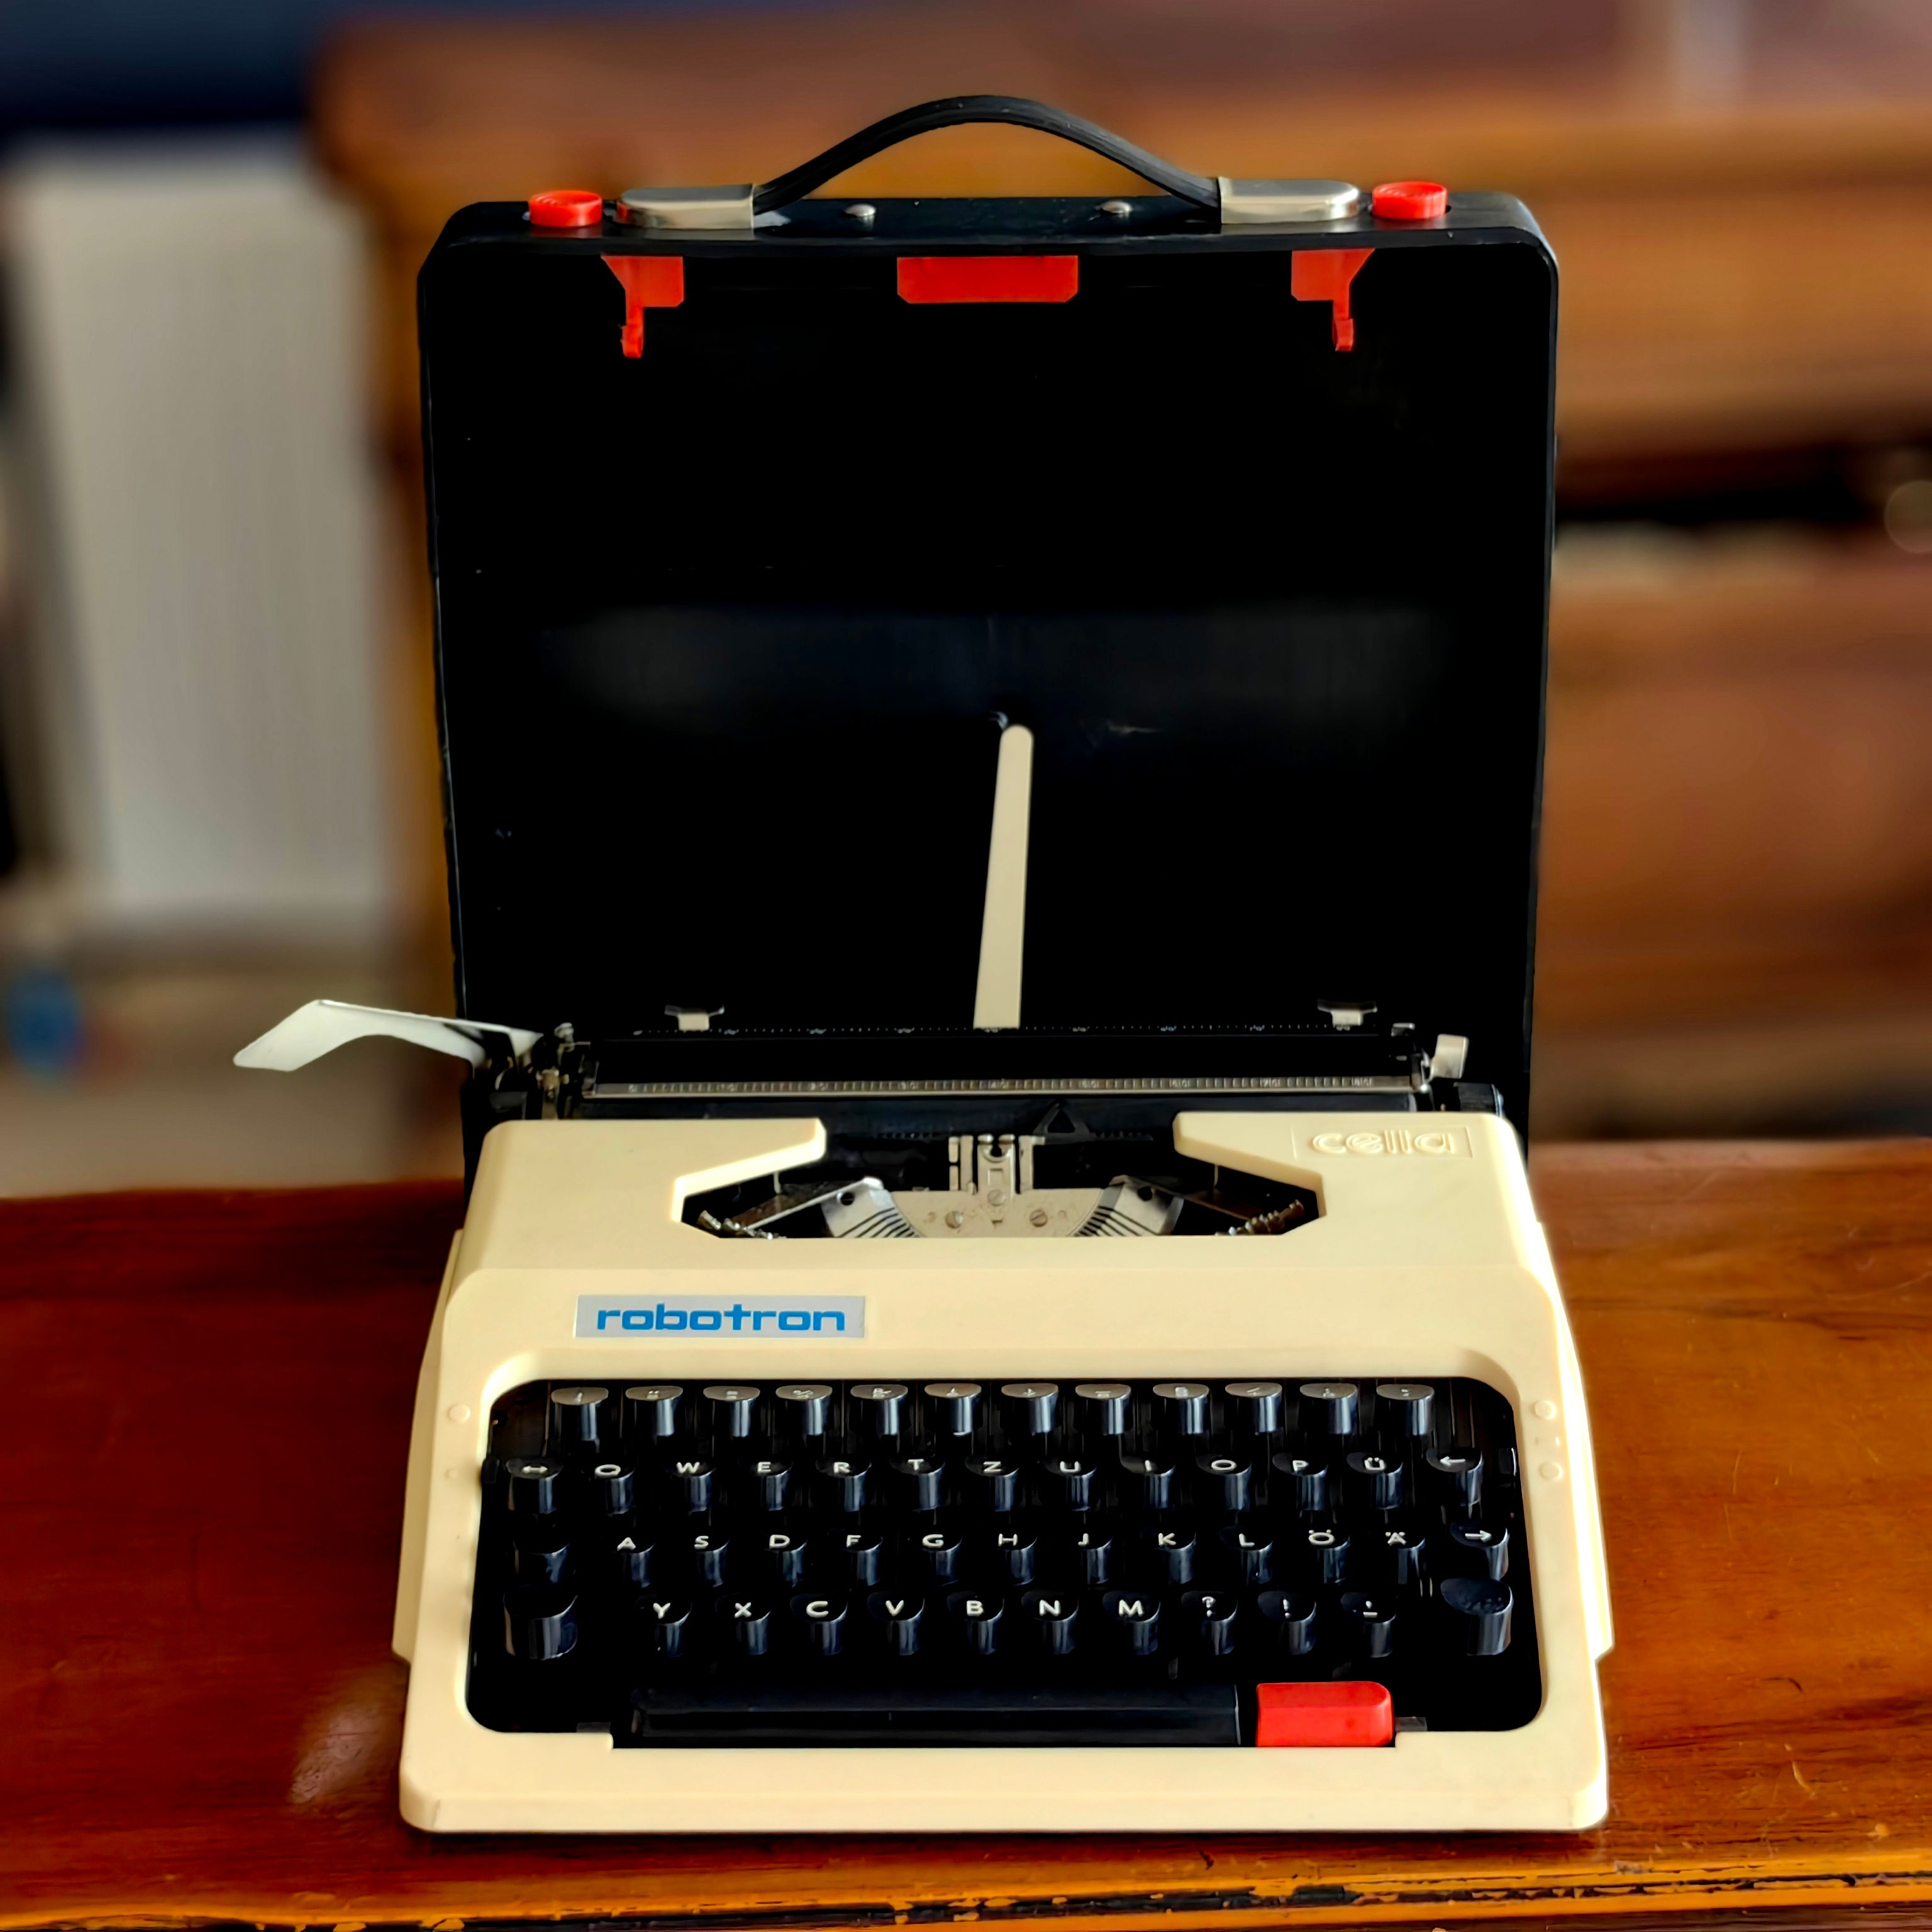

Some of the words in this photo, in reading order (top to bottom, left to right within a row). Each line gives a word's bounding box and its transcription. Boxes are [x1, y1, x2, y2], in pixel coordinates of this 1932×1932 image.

[1313, 1130, 1455, 1154] cella
[597, 1304, 845, 1331] robotron
[676, 1462, 700, 1474] W
[757, 1461, 772, 1474] E
[833, 1462, 850, 1474] R
[908, 1458, 924, 1471] T
[983, 1461, 1002, 1474] Z
[1059, 1461, 1080, 1473] U
[1145, 1460, 1152, 1472] I
[1211, 1459, 1236, 1471] O
[1292, 1460, 1308, 1473] P
[1364, 1457, 1385, 1471] Ü
[617, 1536, 636, 1550] A
[694, 1535, 709, 1548] S
[769, 1534, 791, 1548] D
[846, 1535, 862, 1547] F
[922, 1534, 944, 1547] G
[998, 1533, 1018, 1546] H
[1077, 1533, 1089, 1546] J
[1158, 1533, 1177, 1546] K
[1238, 1533, 1255, 1546] L
[1308, 1529, 1335, 1545] Ö
[1385, 1531, 1406, 1545] Ä
[653, 1602, 671, 1619] Y
[734, 1602, 752, 1618] X
[806, 1601, 829, 1617] C
[885, 1599, 904, 1616] V
[966, 1600, 984, 1616] B
[1039, 1599, 1060, 1616] N
[1118, 1599, 1143, 1616] M
